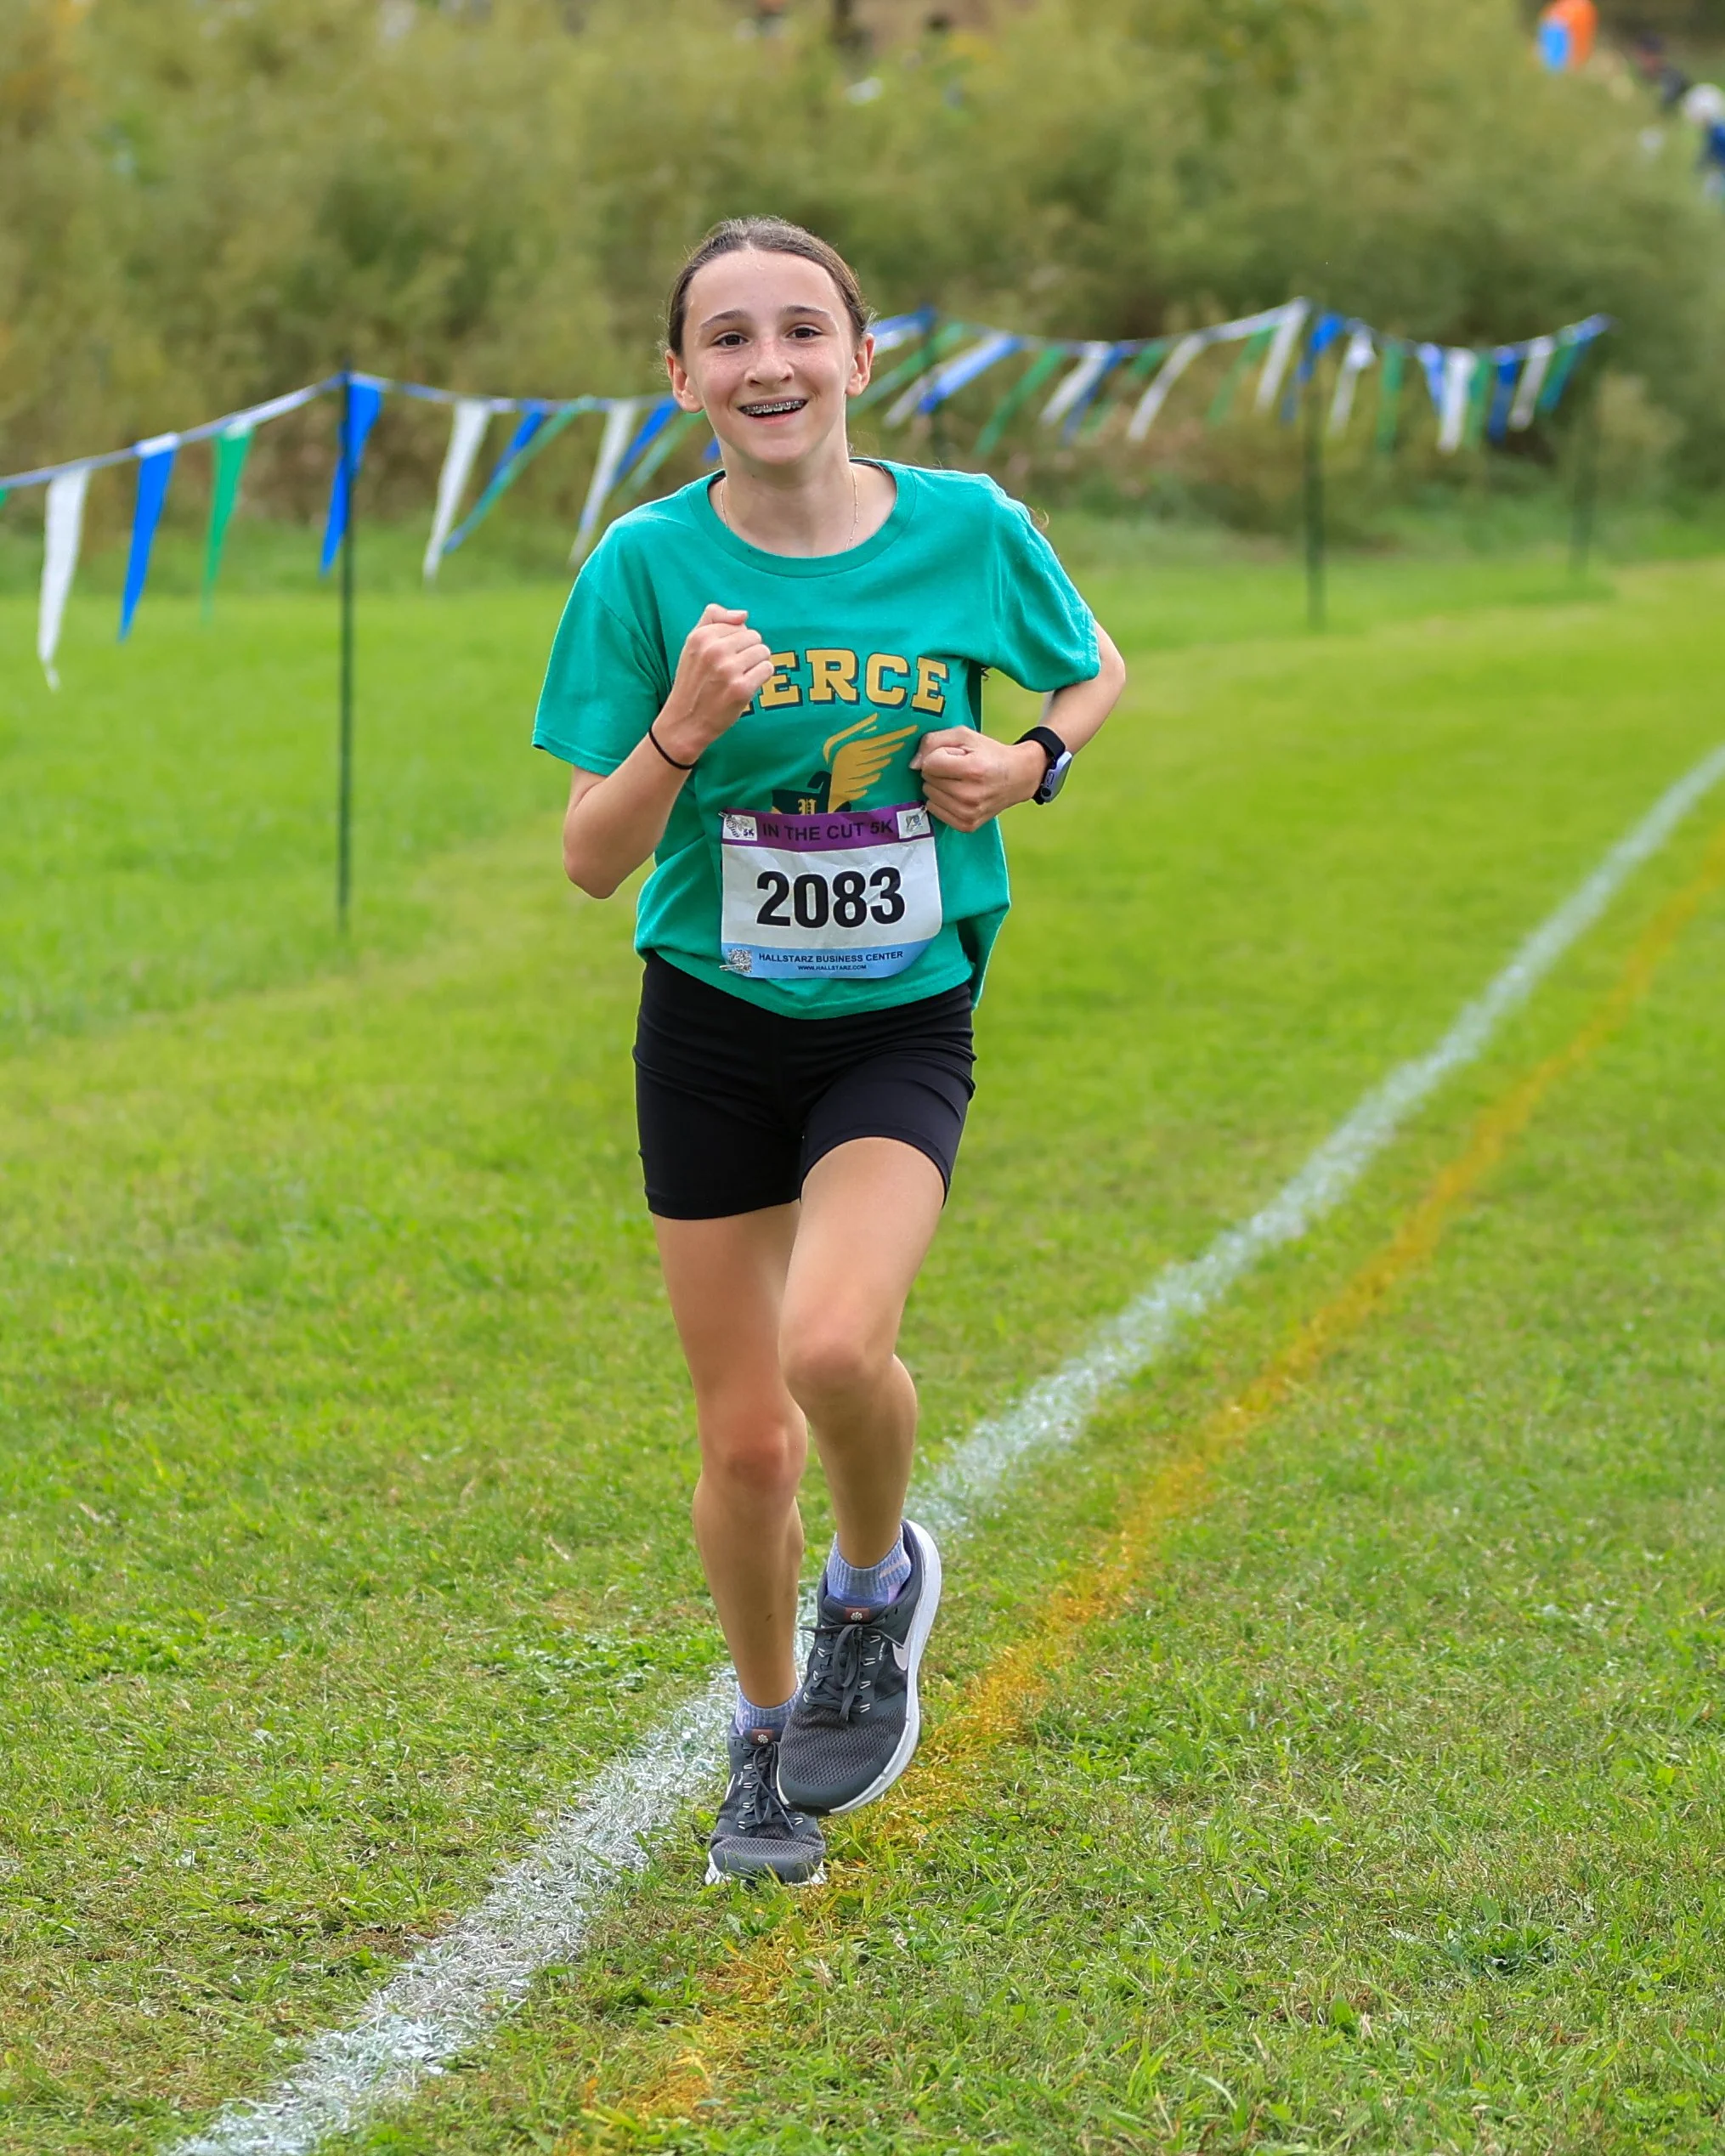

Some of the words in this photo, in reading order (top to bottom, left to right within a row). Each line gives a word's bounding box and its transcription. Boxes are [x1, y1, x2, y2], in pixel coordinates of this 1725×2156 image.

[740, 648, 950, 717] ERCE
[762, 823, 779, 838] IN
[785, 825, 820, 841] THE
[827, 822, 865, 839] CUT
[869, 819, 894, 835] 5K
[756, 866, 906, 929] 2083
[759, 953, 813, 963] HALLSTARZ
[816, 953, 863, 963] BUSINESS
[865, 950, 903, 962] CENTER
